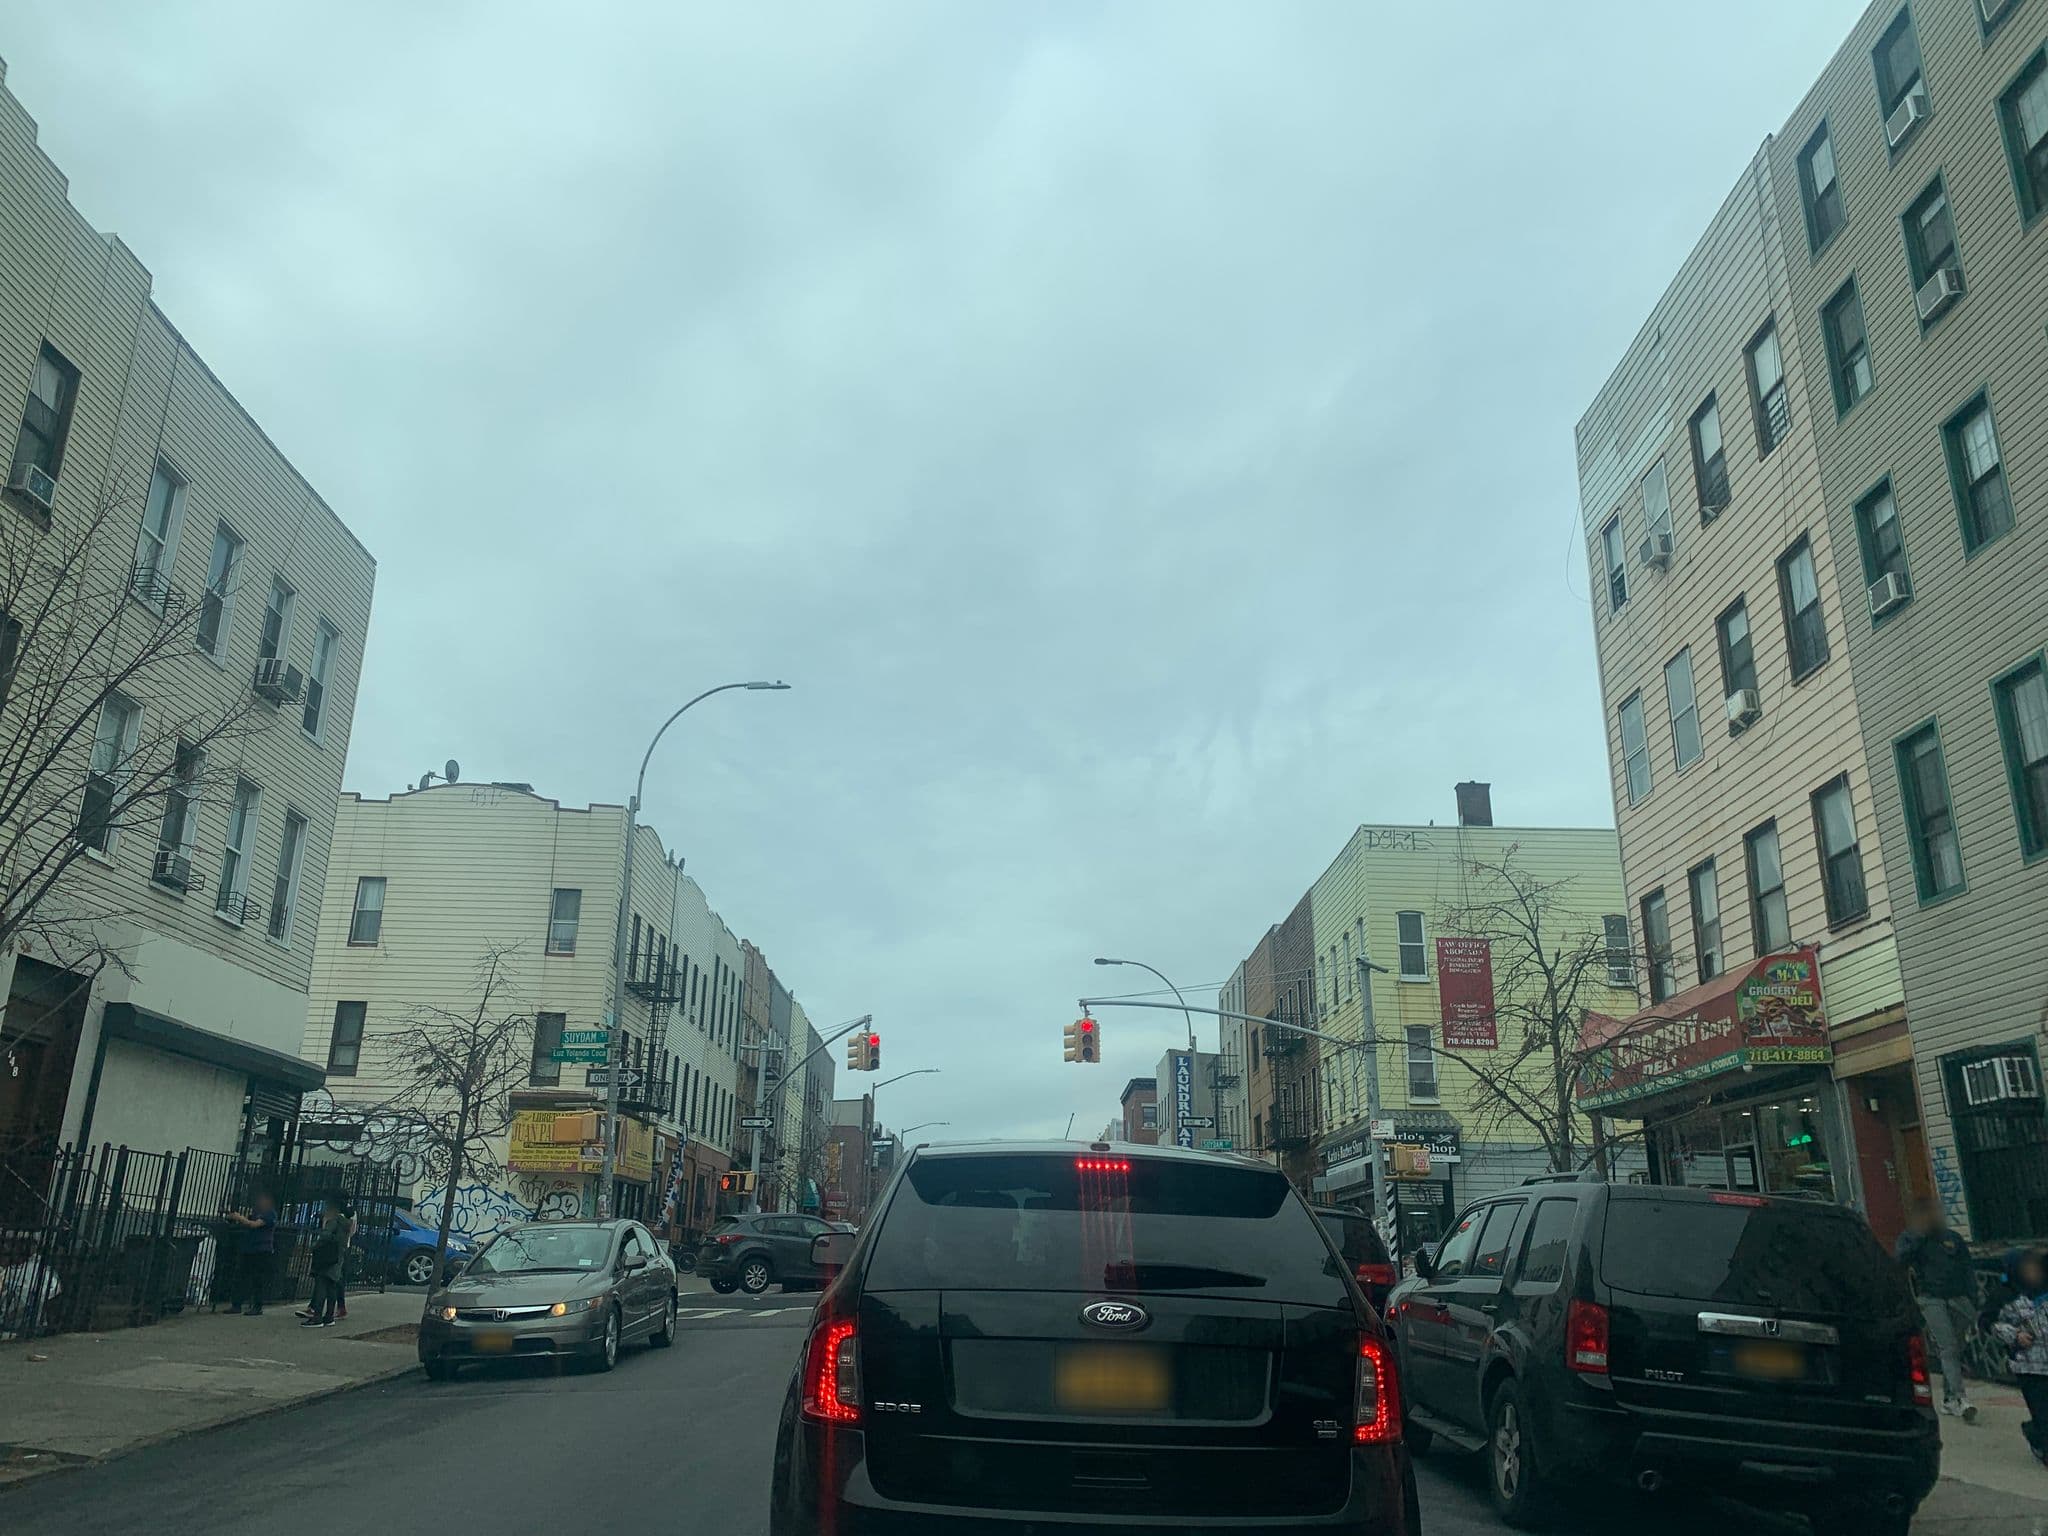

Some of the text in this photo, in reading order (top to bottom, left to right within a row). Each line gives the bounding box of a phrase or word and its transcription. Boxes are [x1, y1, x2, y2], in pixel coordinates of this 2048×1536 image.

[1749, 986, 1797, 995] GROCERY
[1790, 996, 1813, 1005] DELI
[564, 1032, 597, 1043] SUYDAM
[1177, 1057, 1191, 1146] LAUNDROAT
[1423, 1143, 1457, 1155] Shop
[1097, 1305, 1132, 1321] Ford
[1644, 1368, 1684, 1381] PILOT
[874, 1401, 921, 1413] EDGE
